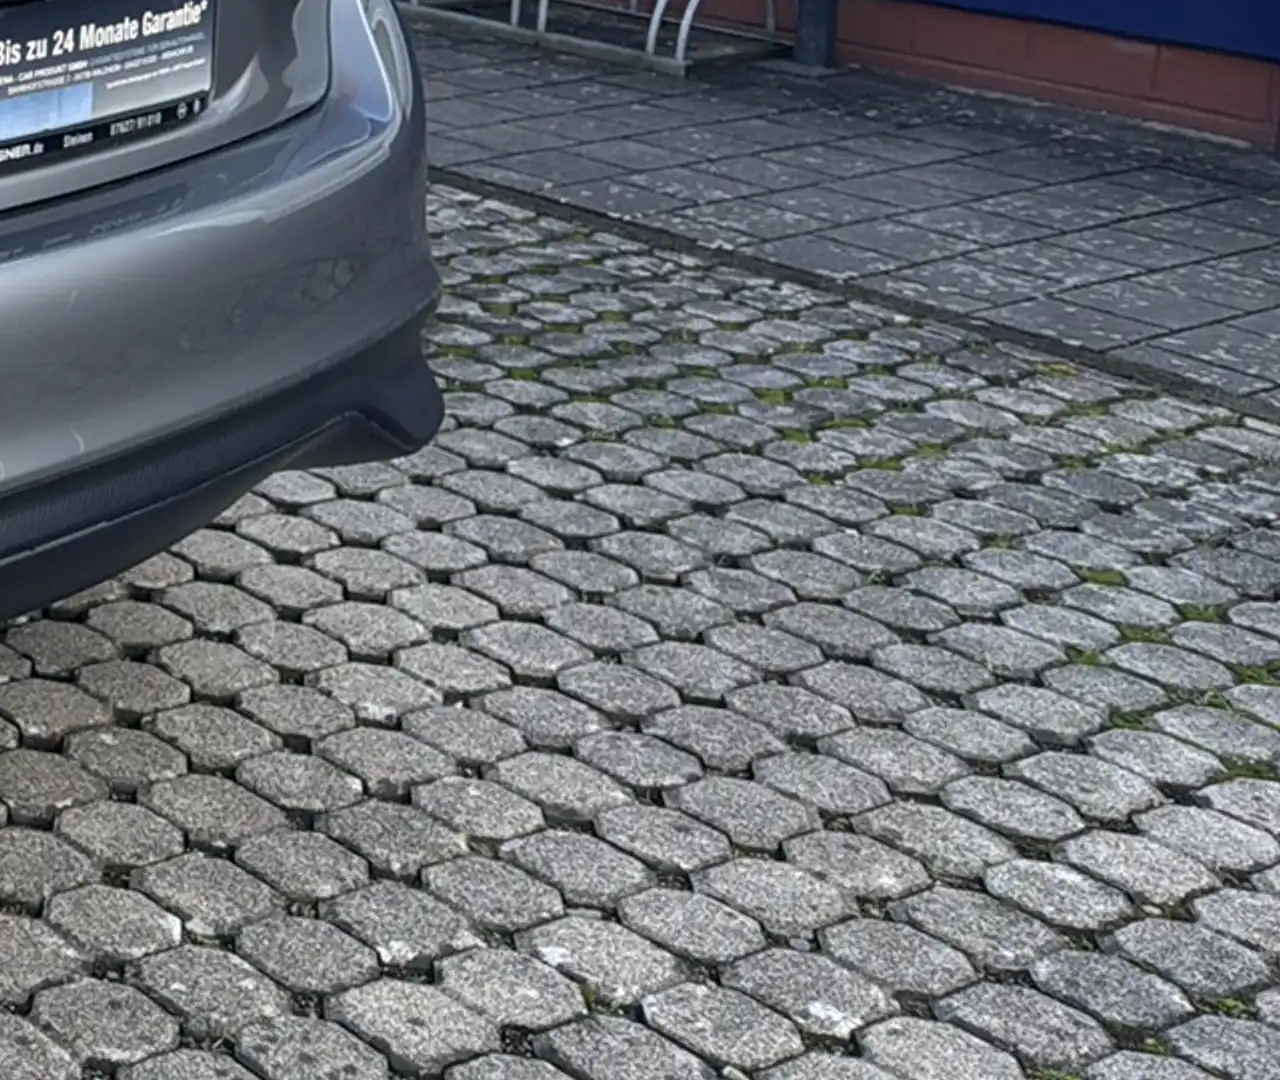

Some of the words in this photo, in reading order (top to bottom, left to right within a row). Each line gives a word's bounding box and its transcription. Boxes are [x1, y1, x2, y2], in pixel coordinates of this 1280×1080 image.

[25, 37, 48, 61] zu
[52, 28, 75, 56] 24
[79, 16, 139, 50] Monate
